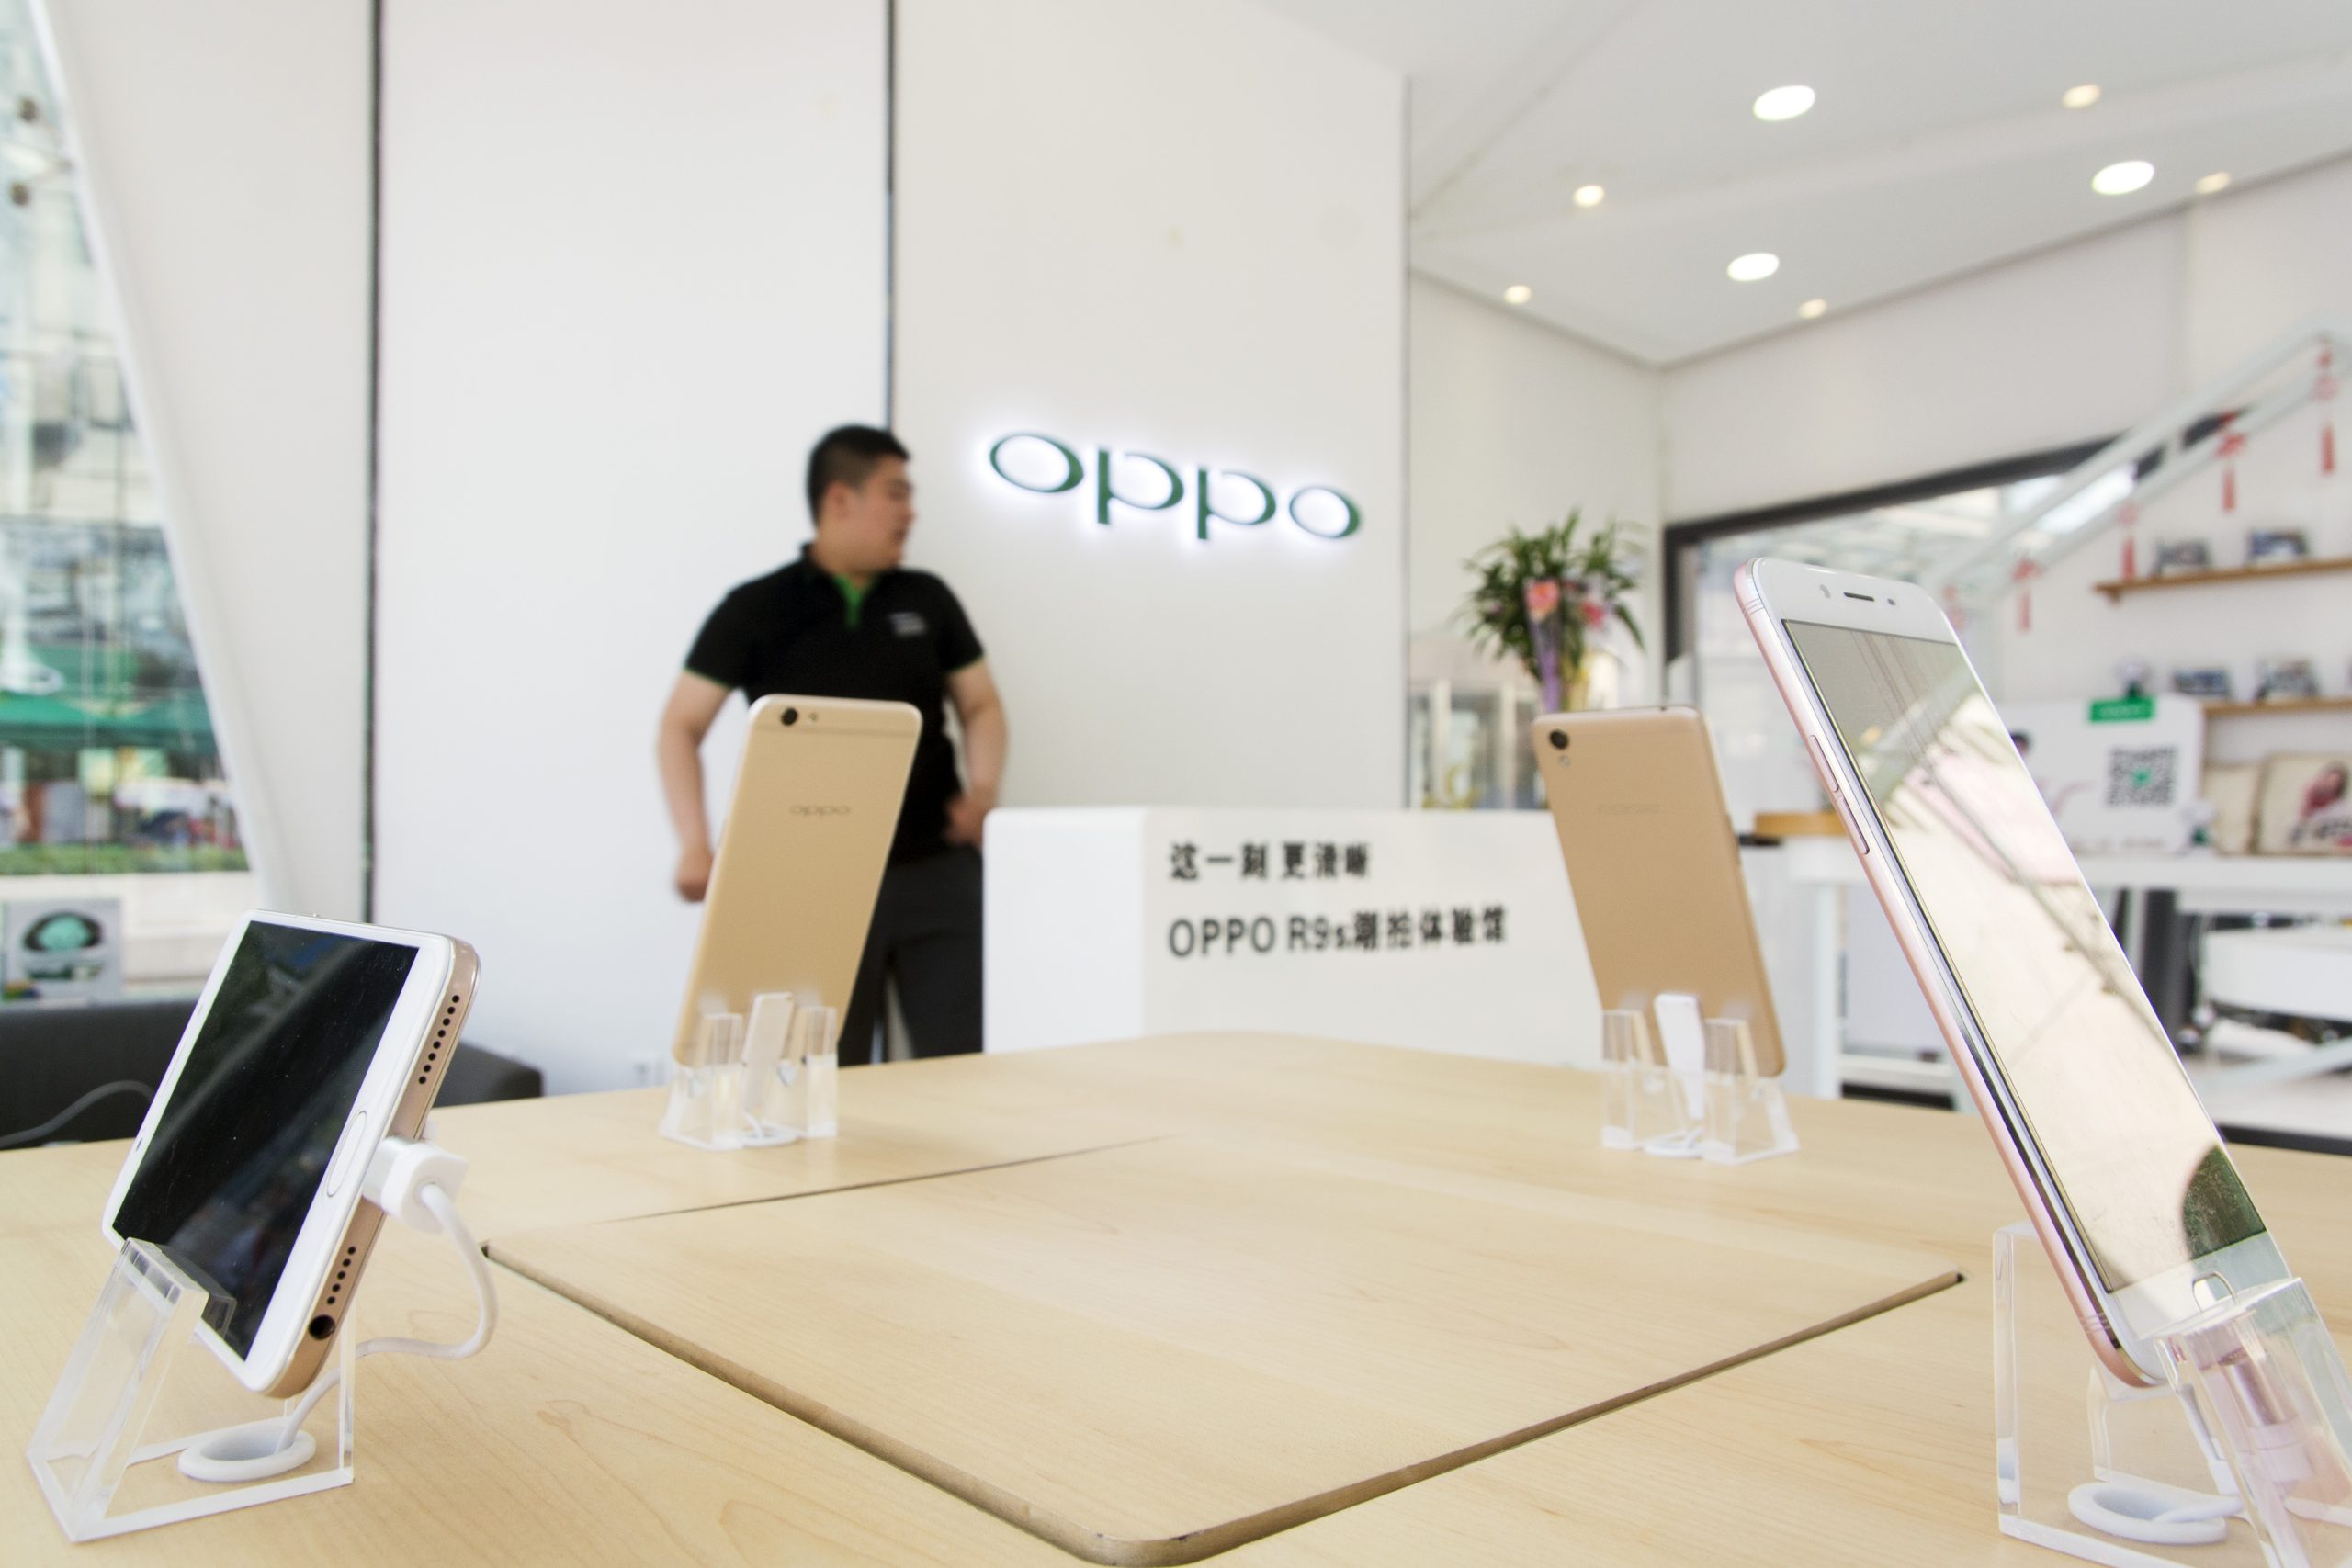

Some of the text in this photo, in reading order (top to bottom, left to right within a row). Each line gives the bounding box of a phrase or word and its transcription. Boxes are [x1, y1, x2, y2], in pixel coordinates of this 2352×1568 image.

[1170, 842, 1269, 881] 这一刻
[1169, 917, 1276, 958] OPPO
